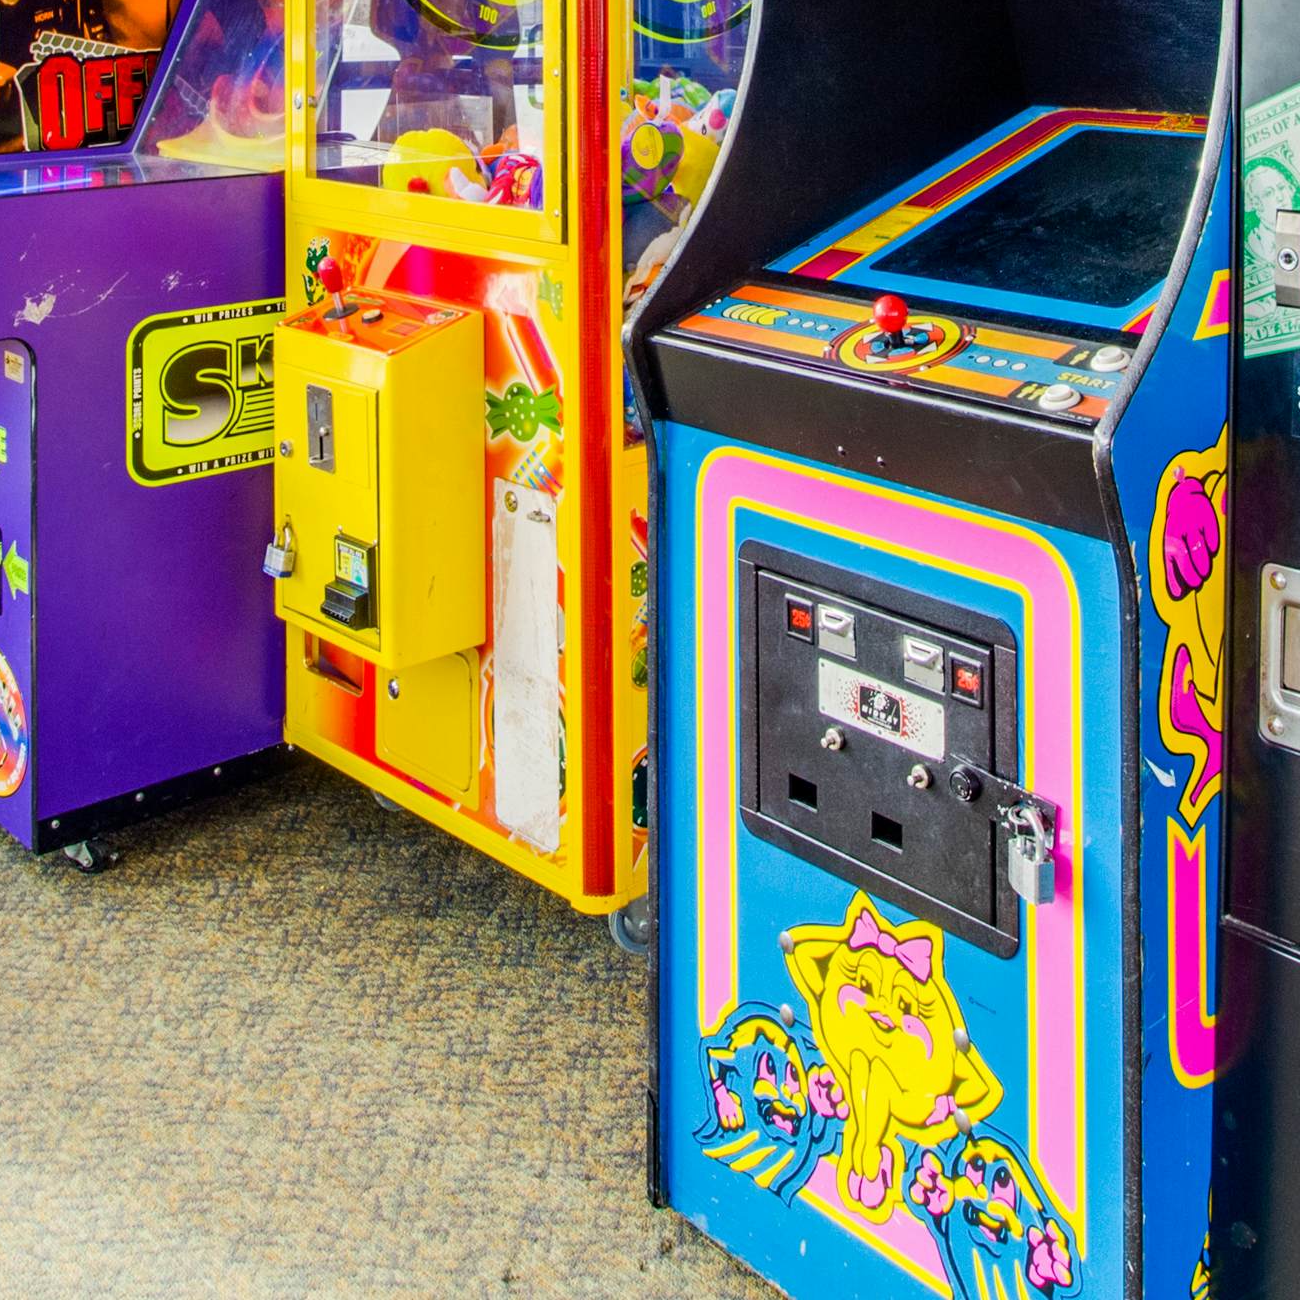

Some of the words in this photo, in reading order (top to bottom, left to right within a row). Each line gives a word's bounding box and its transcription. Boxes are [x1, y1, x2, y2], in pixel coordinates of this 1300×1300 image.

[478, 4, 499, 24] 100
[1272, 114, 1292, 137] OF
[194, 312, 214, 324] WIN
[218, 306, 254, 321] PRIZES
[132, 367, 142, 400] POINTS
[1058, 371, 1117, 390] START
[188, 463, 208, 474] WIN
[213, 459, 220, 469] A
[224, 452, 253, 467] PRIZE
[860, 703, 899, 726] MIDWAY
